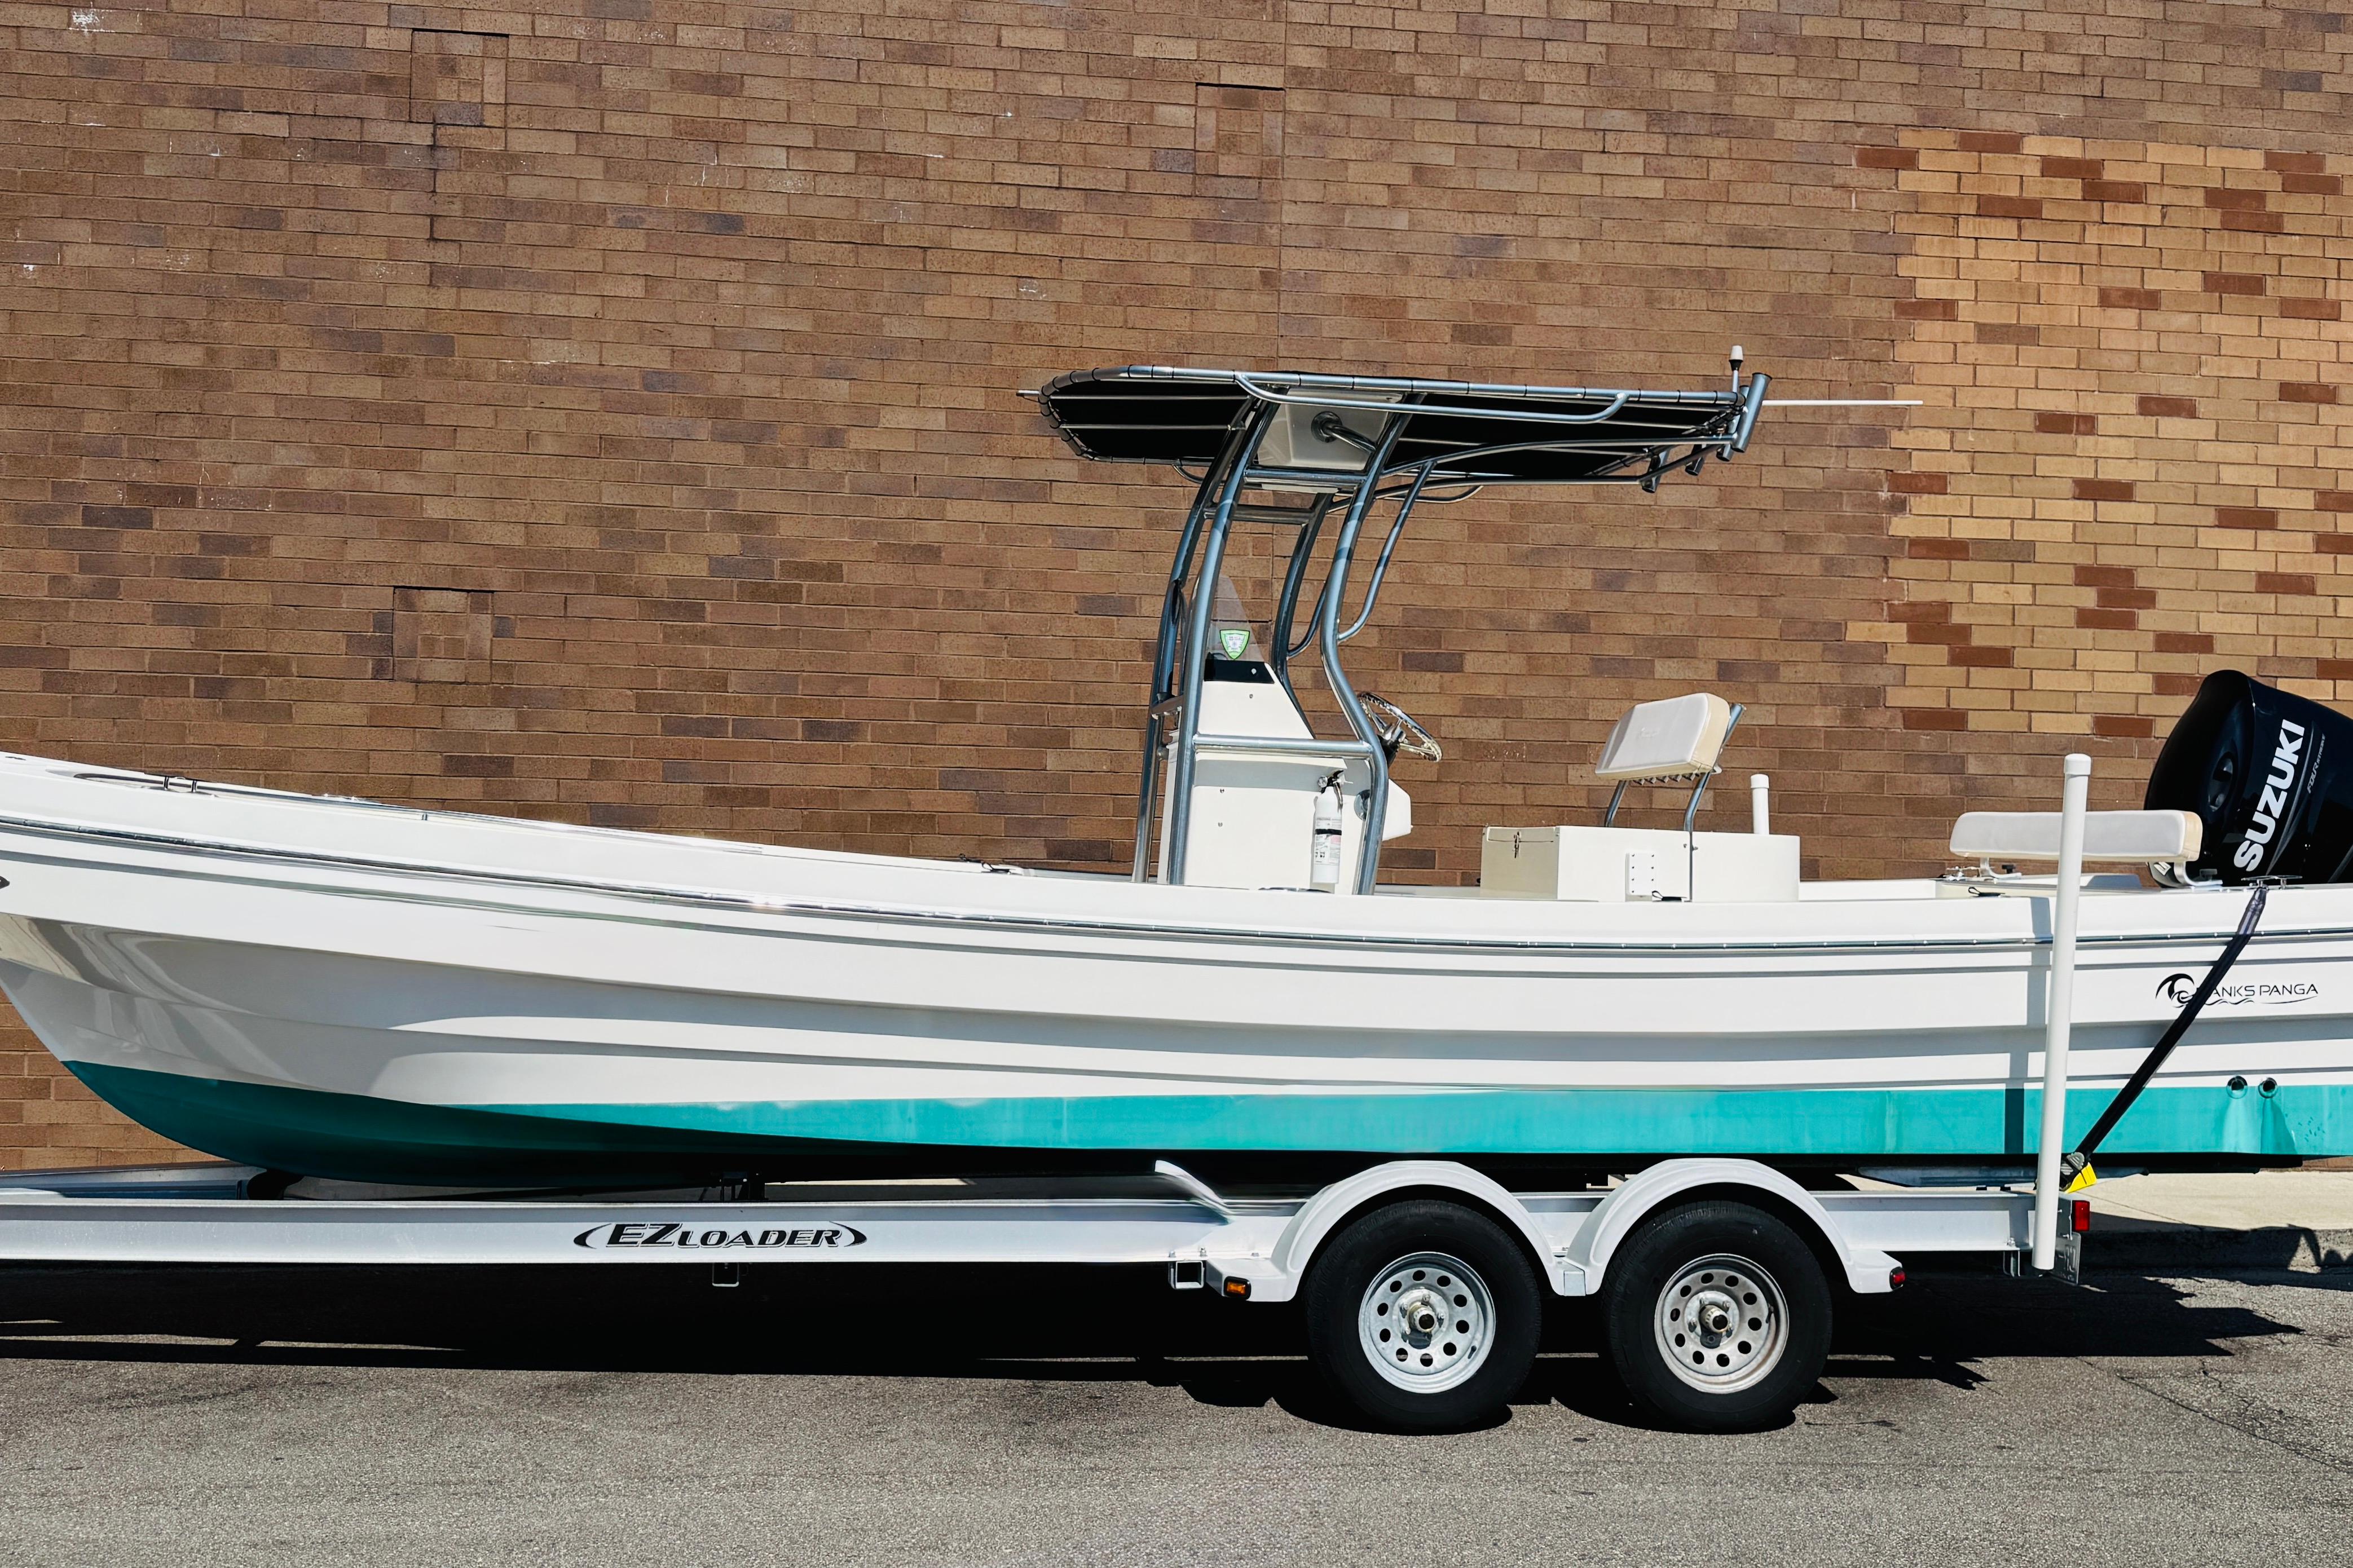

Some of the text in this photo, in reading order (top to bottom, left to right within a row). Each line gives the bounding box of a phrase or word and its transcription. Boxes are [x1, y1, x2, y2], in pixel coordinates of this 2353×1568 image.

[2233, 719, 2305, 872] SUZUKI
[2197, 983, 2319, 998] ANKS PANGA
